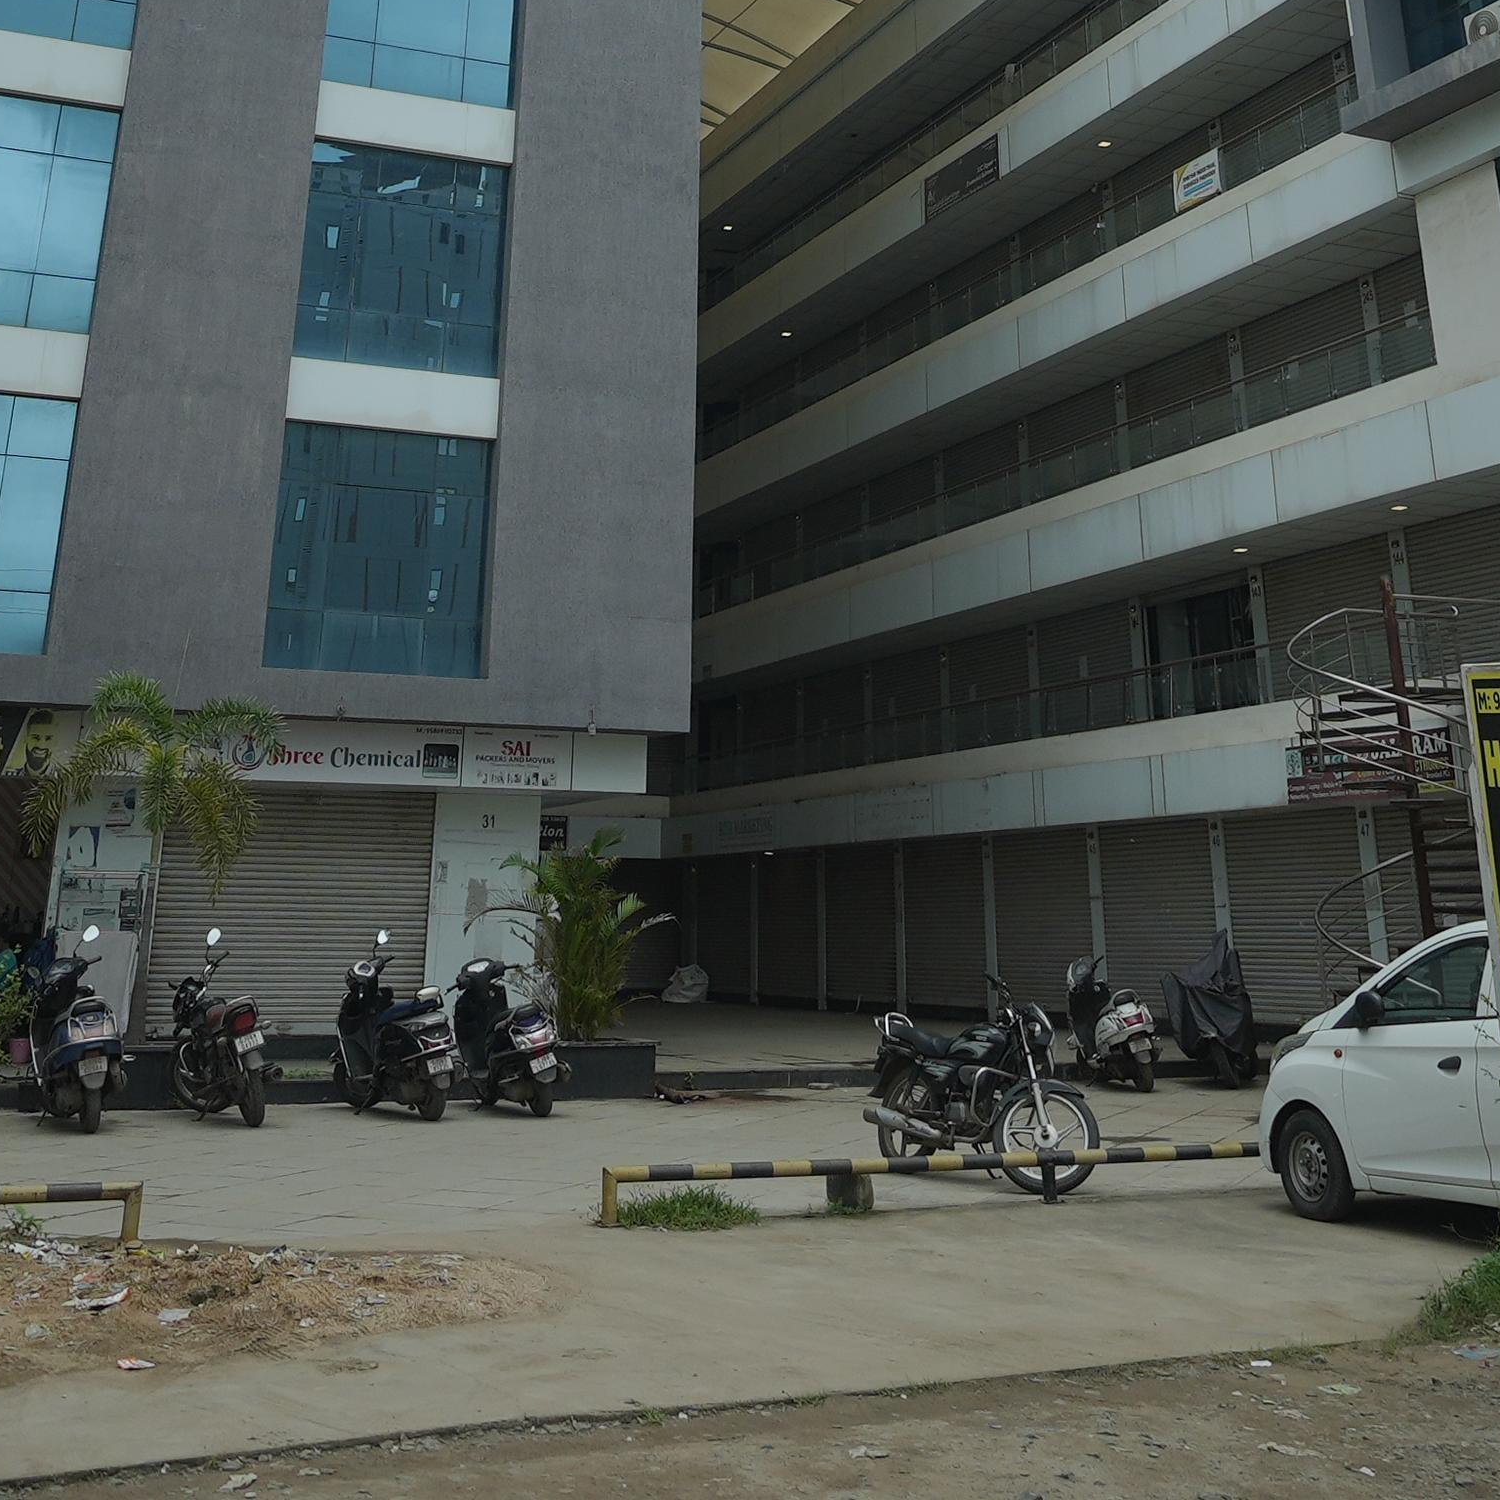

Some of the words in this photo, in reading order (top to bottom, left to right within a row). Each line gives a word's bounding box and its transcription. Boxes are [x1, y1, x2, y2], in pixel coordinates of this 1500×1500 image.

[1477, 691, 1492, 710] M:
[501, 740, 531, 756] SAI
[330, 746, 421, 769] Chemical
[509, 755, 525, 763] AND
[526, 756, 555, 764] MOVERS
[482, 814, 496, 829] 31
